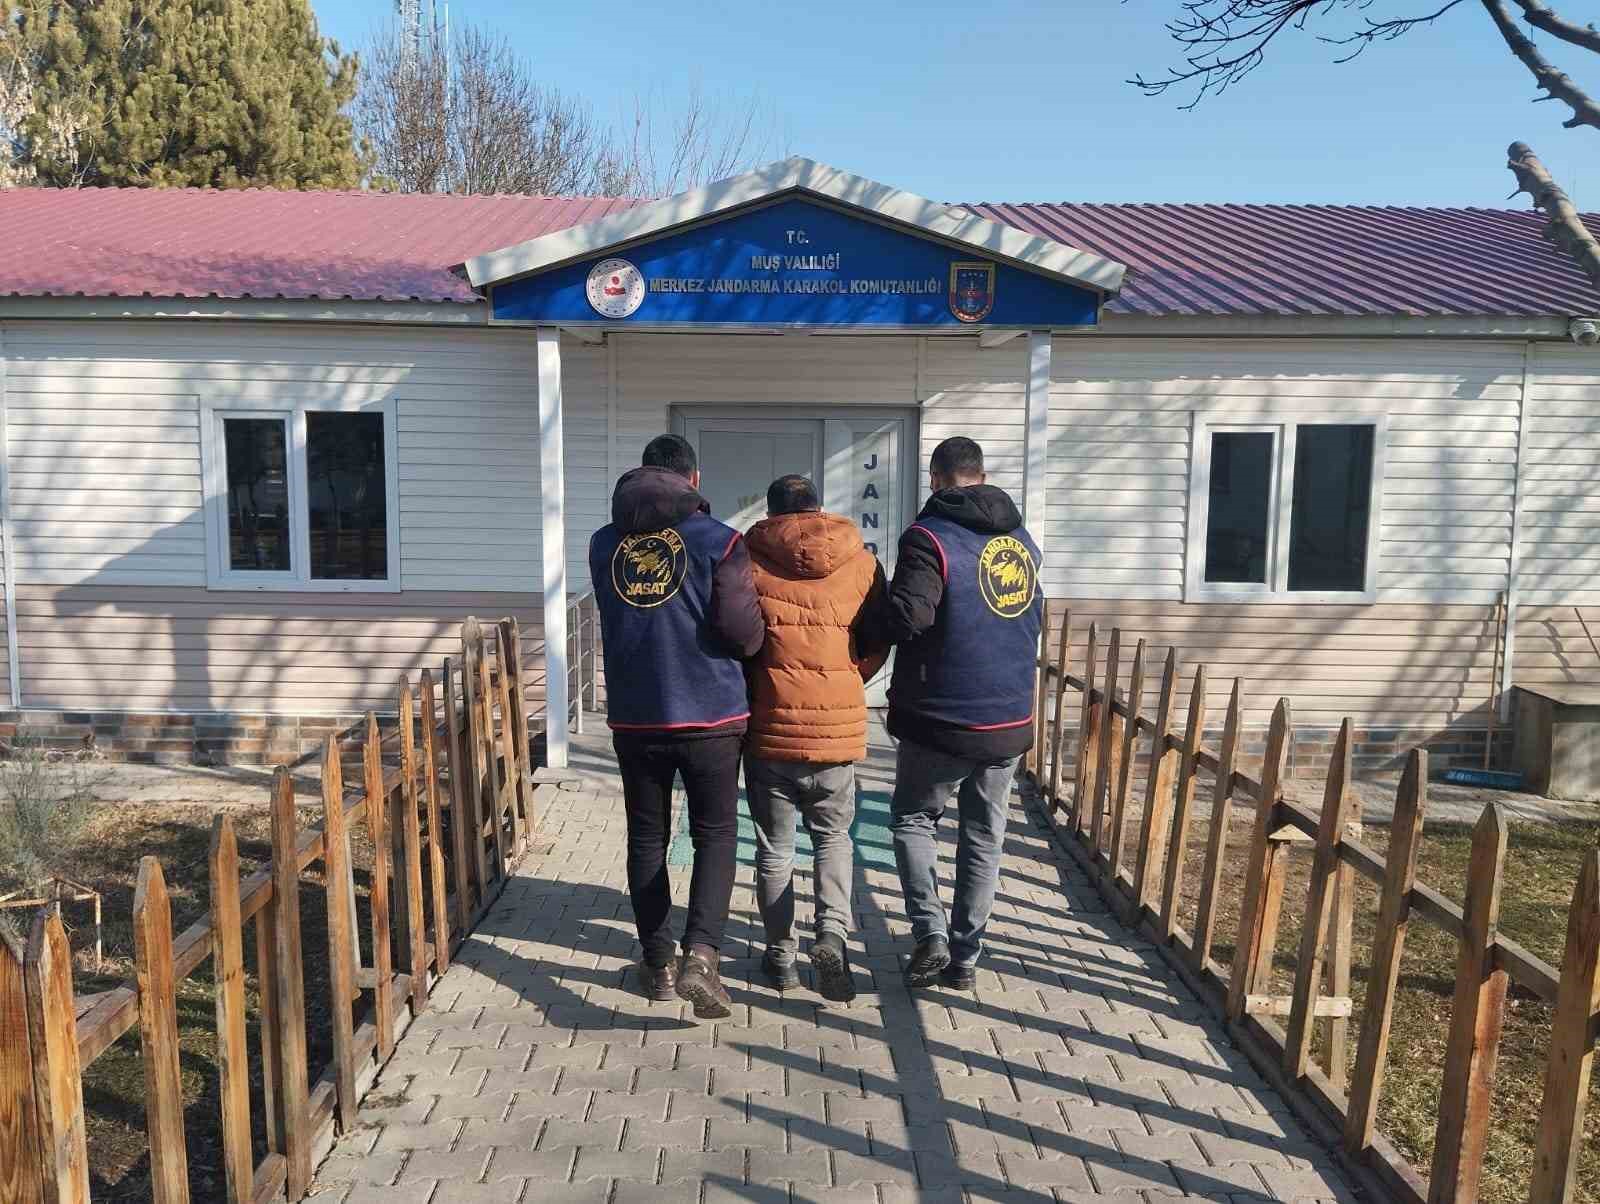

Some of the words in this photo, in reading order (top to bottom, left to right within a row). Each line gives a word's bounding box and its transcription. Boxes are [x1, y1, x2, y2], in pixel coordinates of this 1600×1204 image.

[751, 255, 780, 272] MUŞ
[649, 279, 705, 292] MERKEZ
[707, 279, 780, 293] JANDARMA
[783, 279, 848, 293] KARAKOL
[982, 539, 1028, 569] JANDARMA
[627, 582, 667, 596] JASAT
[996, 591, 1028, 609] JASAT
